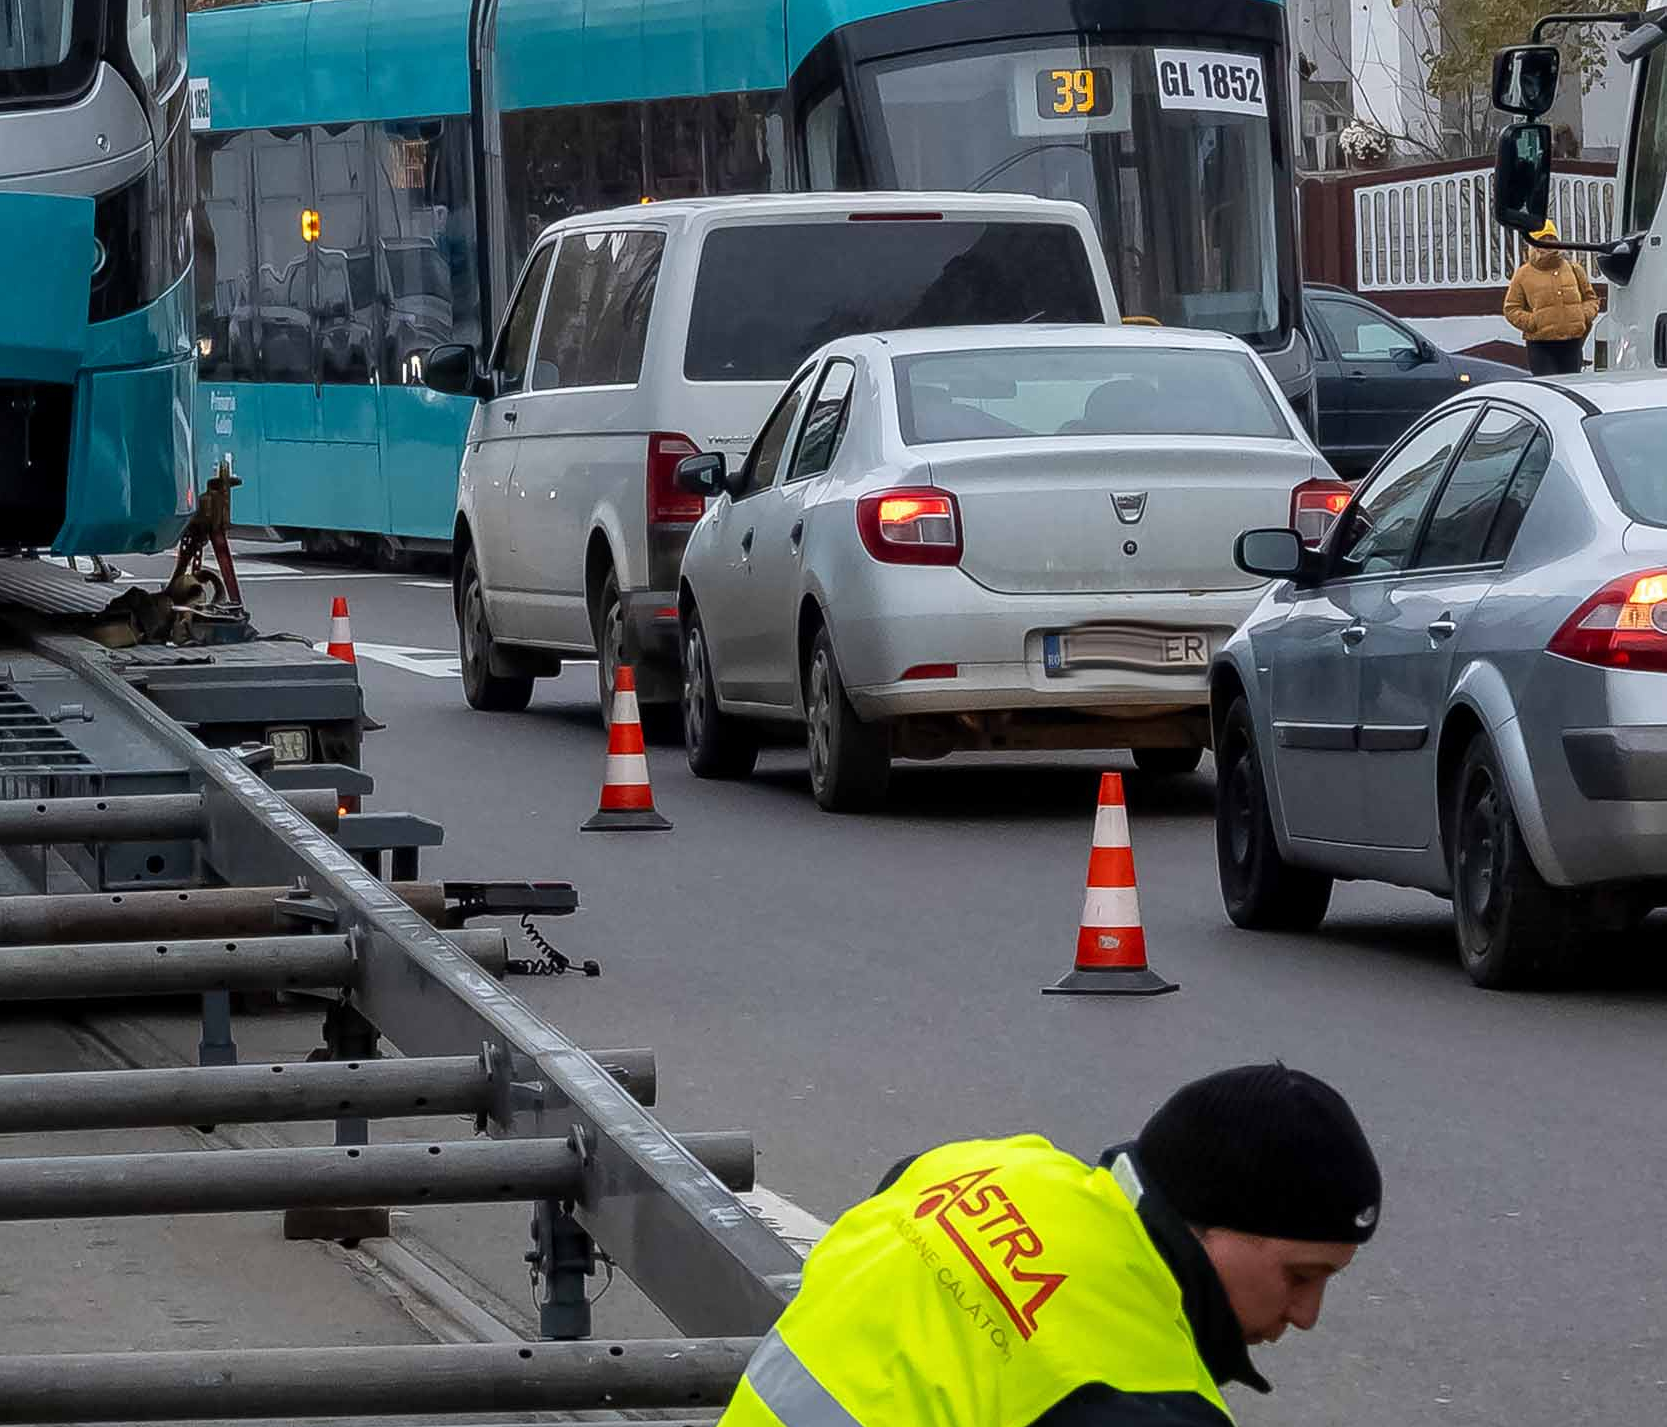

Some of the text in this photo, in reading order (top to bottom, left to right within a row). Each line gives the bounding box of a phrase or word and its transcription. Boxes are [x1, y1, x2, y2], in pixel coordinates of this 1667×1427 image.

[1051, 68, 1095, 114] 39
[1160, 60, 1263, 104] GL 1852
[914, 1166, 1069, 1341] ASTRA
